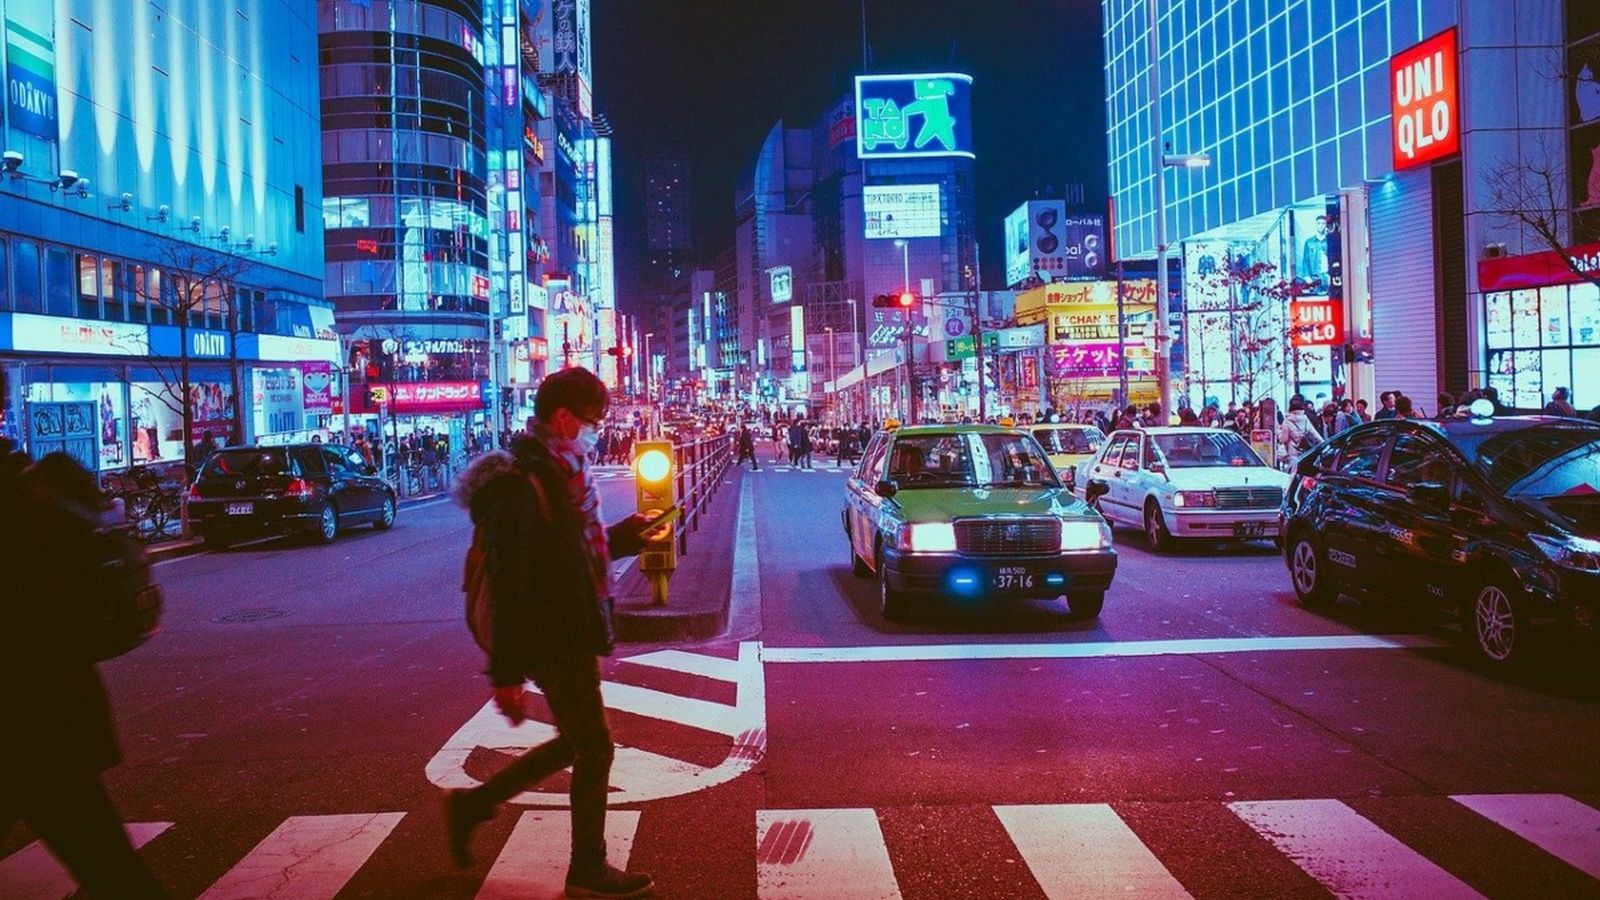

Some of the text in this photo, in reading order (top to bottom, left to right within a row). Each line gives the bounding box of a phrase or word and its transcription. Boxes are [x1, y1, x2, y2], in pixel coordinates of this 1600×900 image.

[1396, 51, 1443, 106] UNI
[11, 79, 54, 120] ODAKYU
[1397, 101, 1449, 159] QLO
[1055, 315, 1116, 325] ECHANE
[1300, 306, 1332, 322] UNI
[194, 331, 225, 356] ODAKYU
[1055, 347, 1119, 364] チケット
[998, 575, 1033, 588] 37-16
